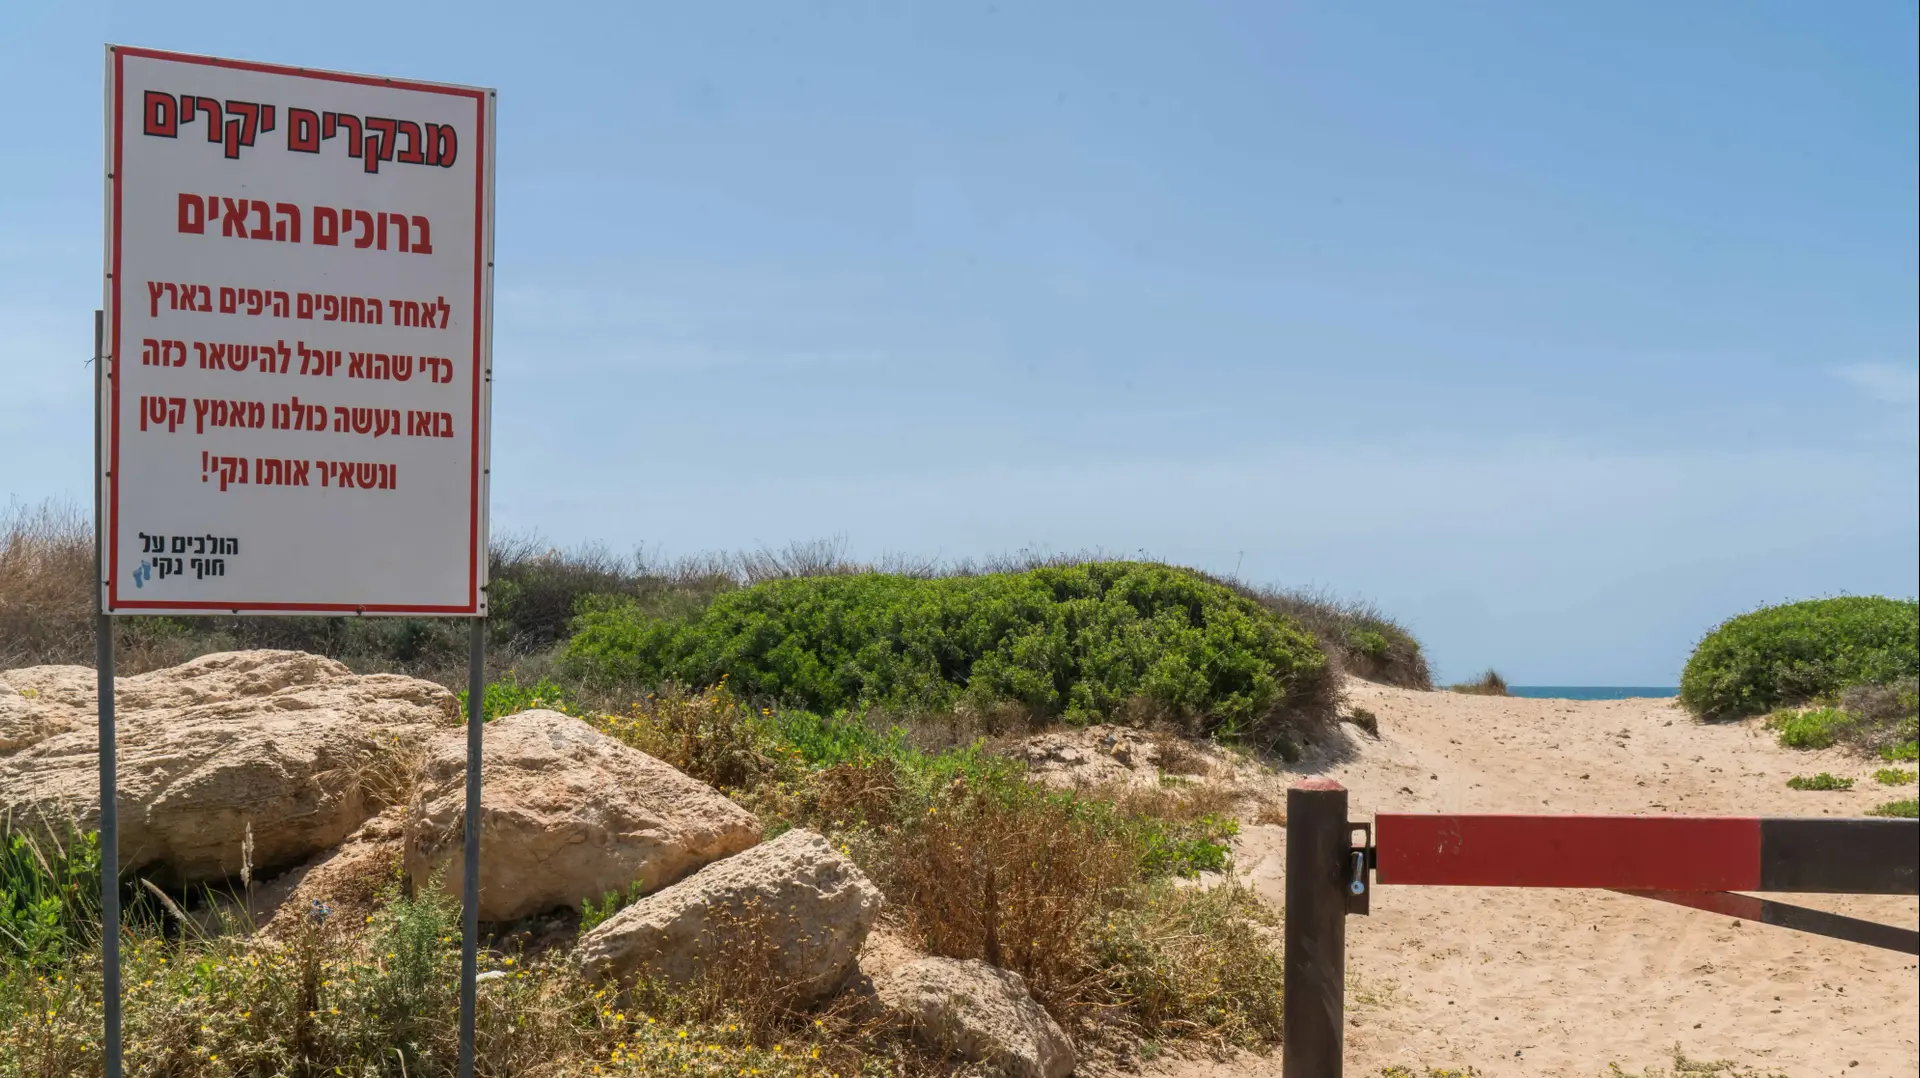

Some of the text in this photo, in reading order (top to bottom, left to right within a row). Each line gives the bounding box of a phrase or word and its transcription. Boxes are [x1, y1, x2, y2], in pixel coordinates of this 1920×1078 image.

[143, 89, 458, 175] מבקרים יקרים
[177, 192, 433, 255] ברוכים הבאים
[147, 281, 451, 330] לאחד החופים היפים בארץ
[142, 338, 454, 384] כדי שהוא יוכל להישאר כזה
[139, 395, 454, 439] בואו נעשה כולנו מאמץ קטן
[201, 450, 397, 492] ונשאיר אותו נקי!
[138, 531, 239, 556] הולכים על
[152, 556, 225, 580] חוף נקי
